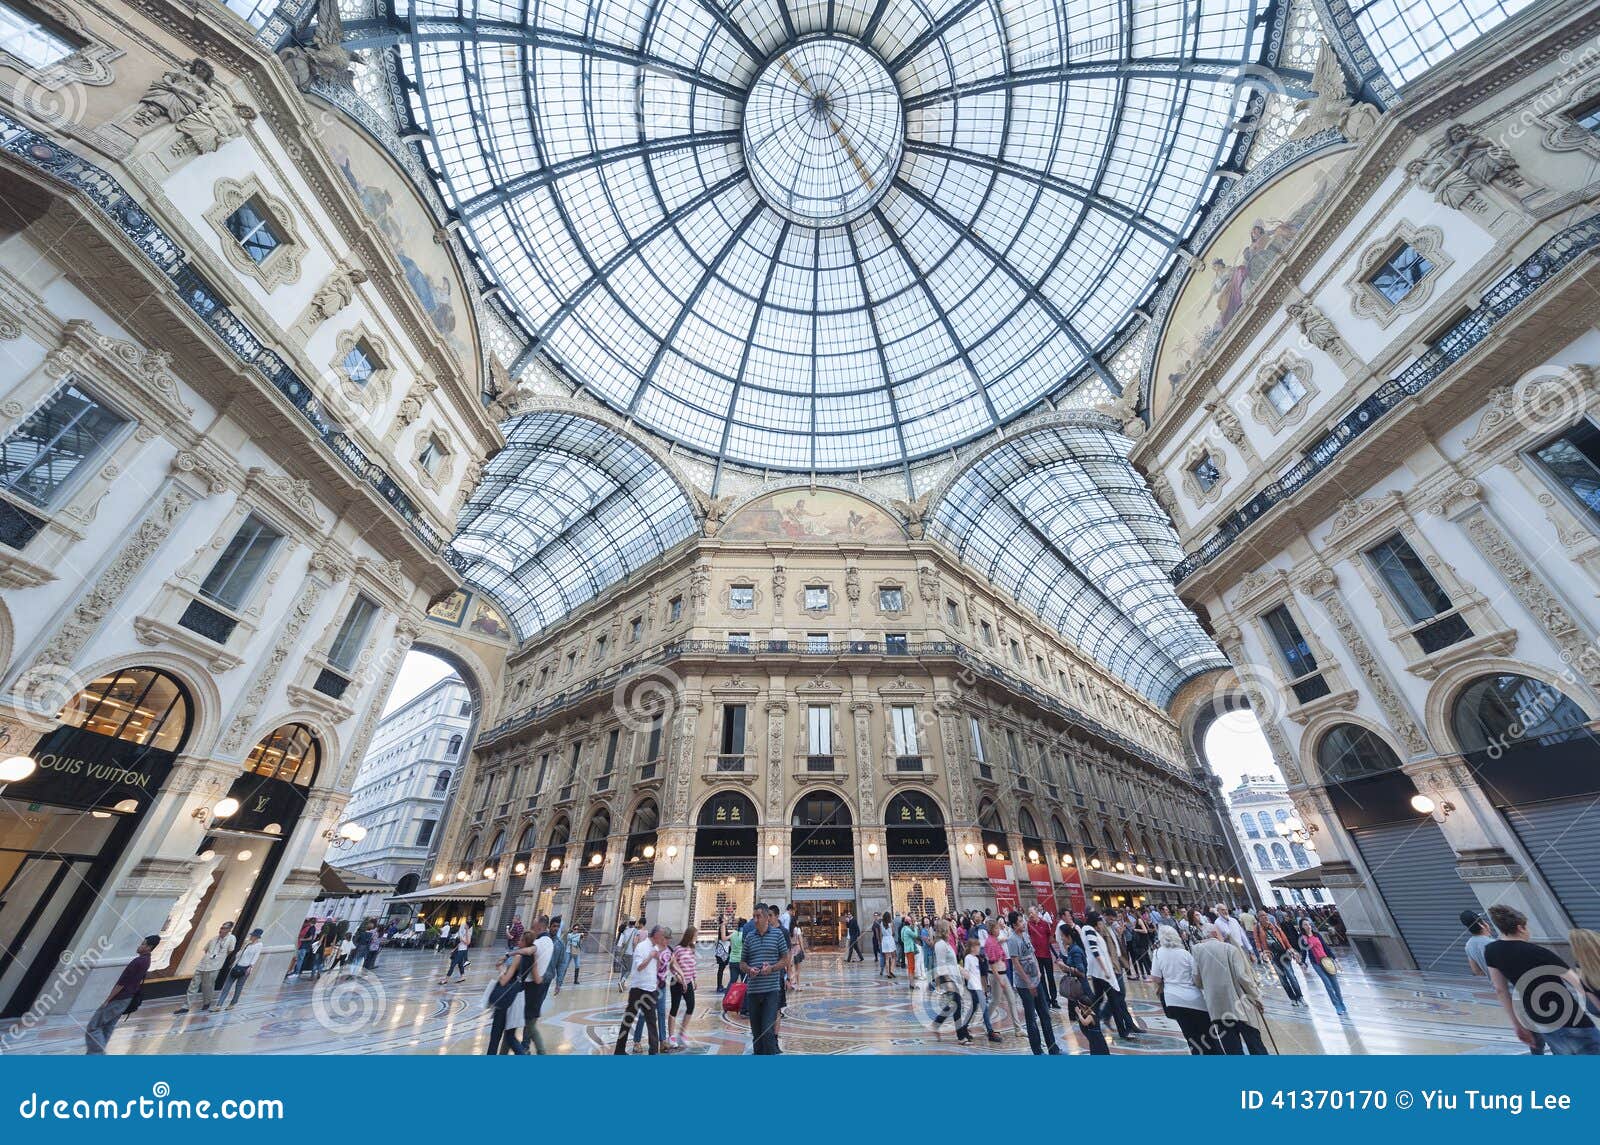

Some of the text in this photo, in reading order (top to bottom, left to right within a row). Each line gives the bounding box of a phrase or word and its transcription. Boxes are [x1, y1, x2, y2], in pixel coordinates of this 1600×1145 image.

[87, 762, 151, 787] VUITTON
[807, 838, 837, 846] PRADA
[902, 838, 931, 846] PRADA
